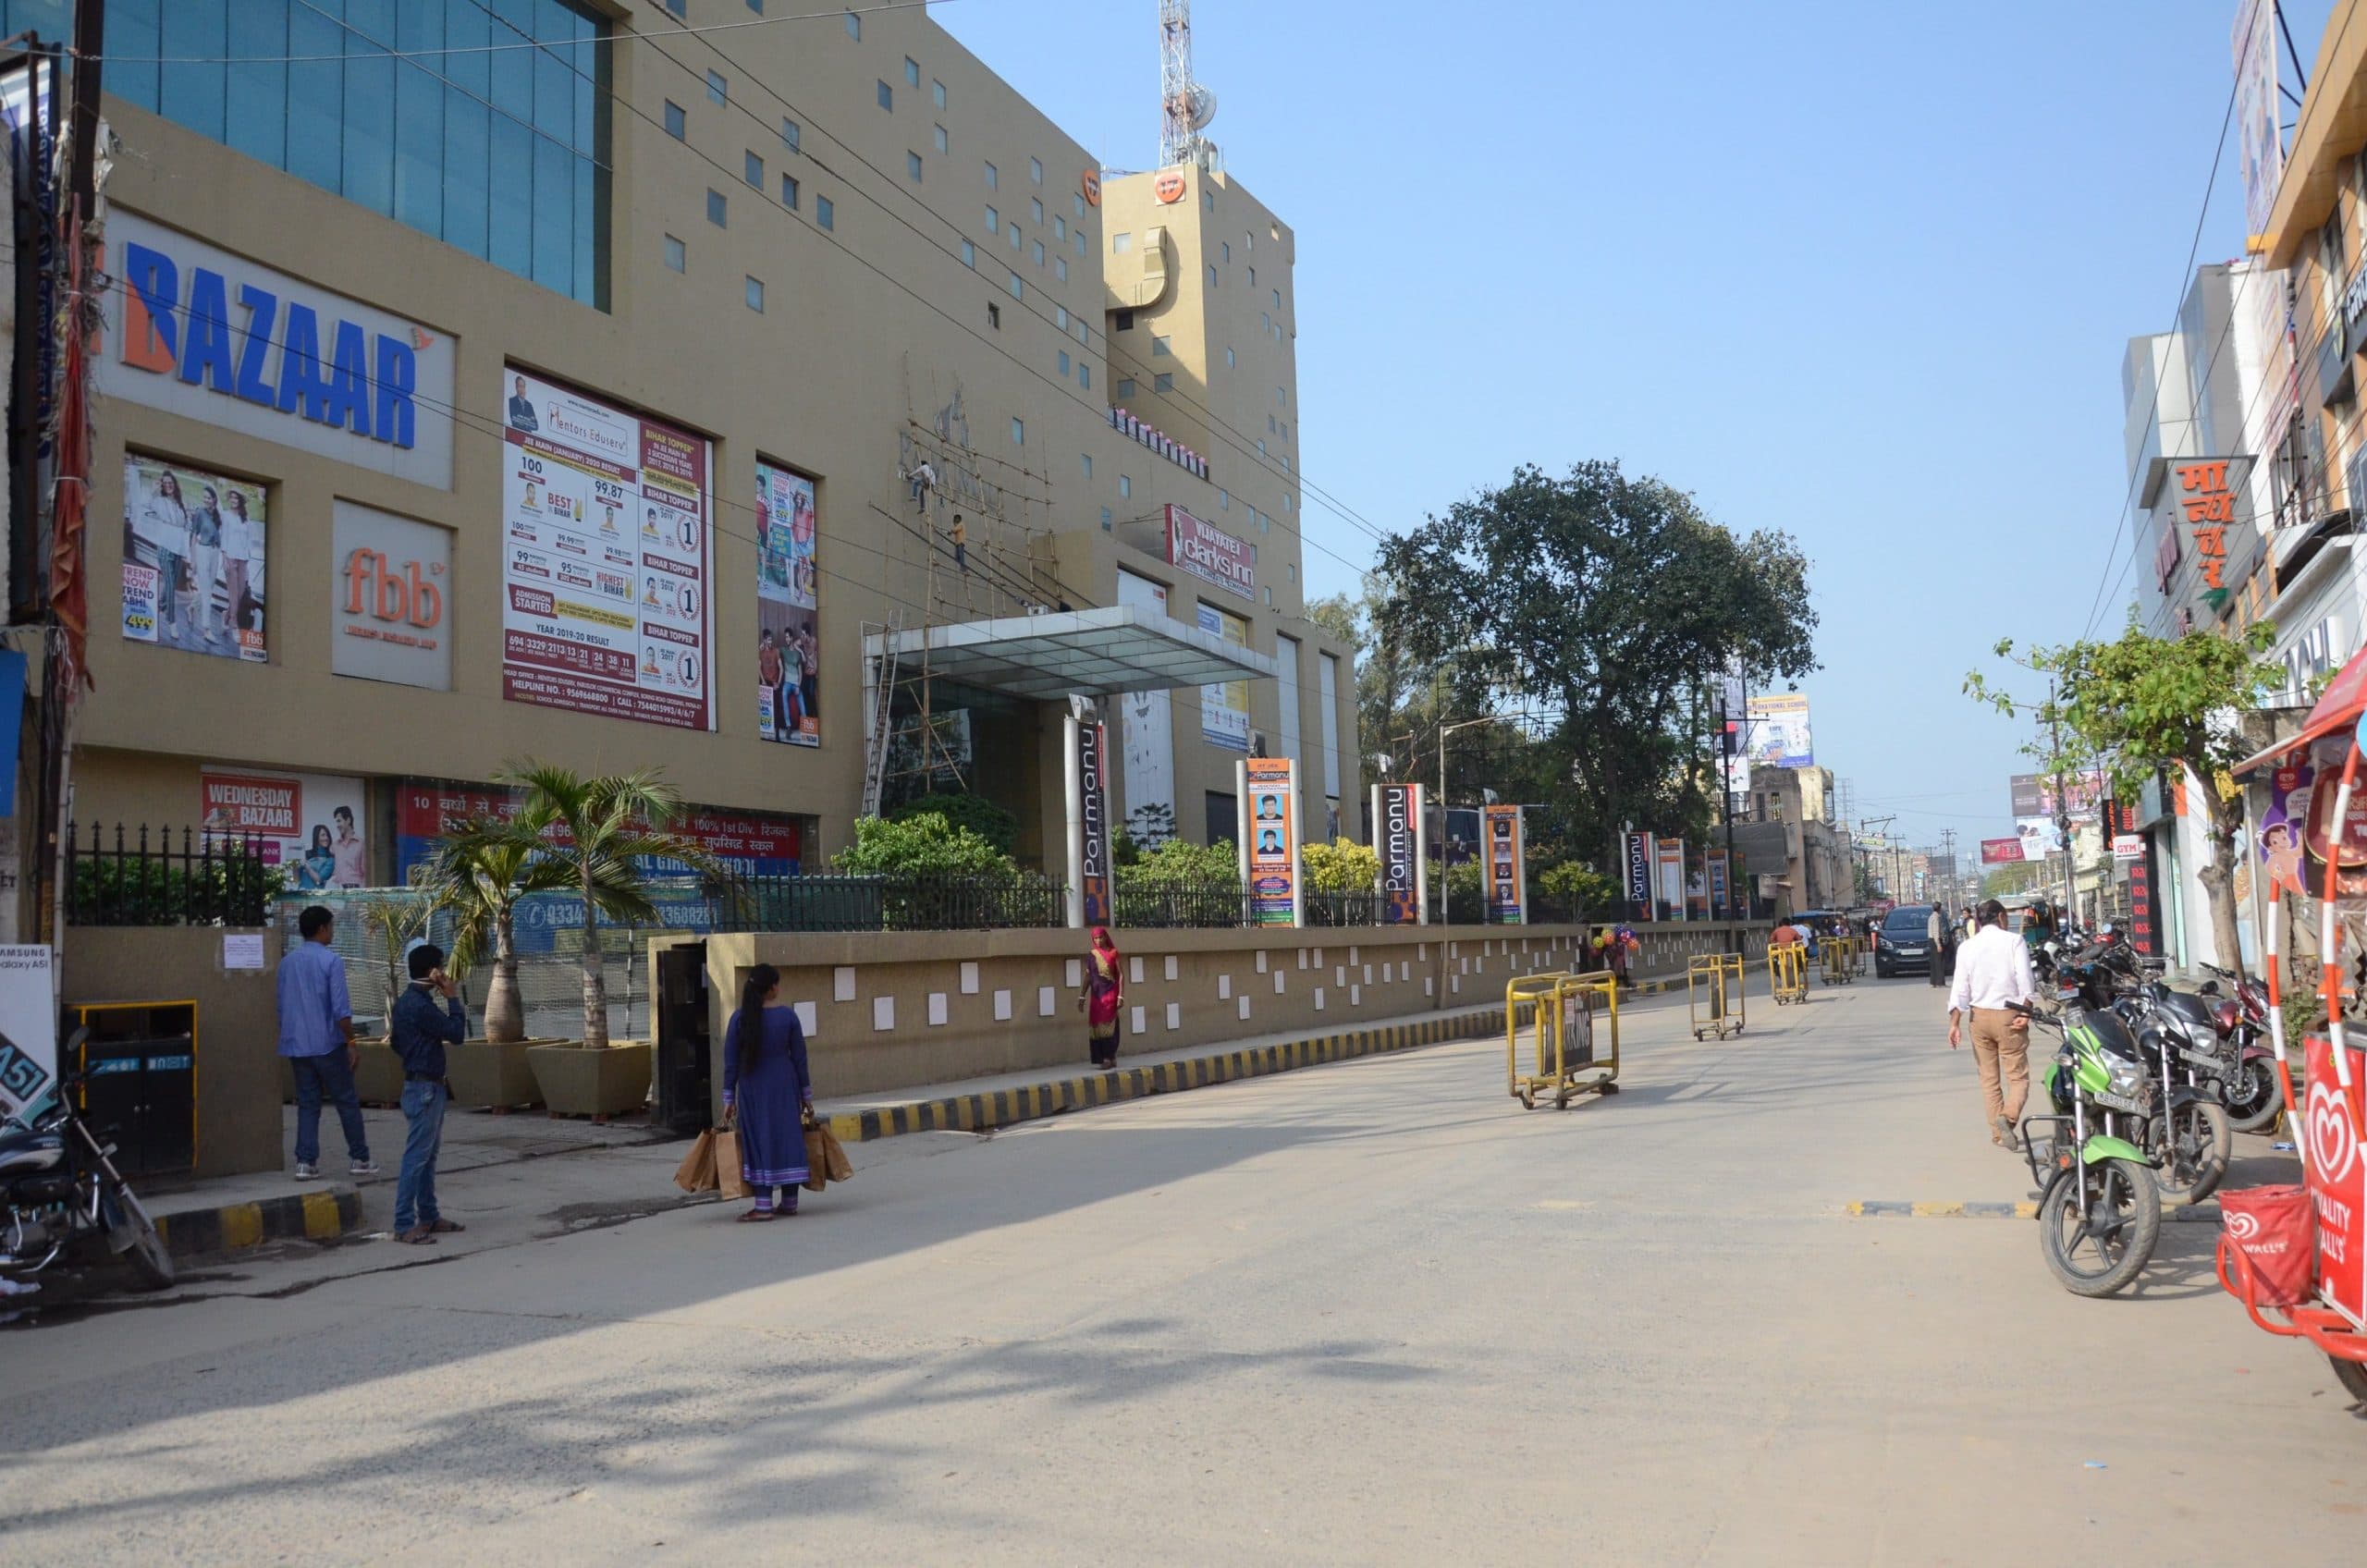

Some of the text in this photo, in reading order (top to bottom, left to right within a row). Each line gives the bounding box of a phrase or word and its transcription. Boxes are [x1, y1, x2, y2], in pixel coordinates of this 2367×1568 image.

[120, 241, 416, 449] BAZAAR
[550, 407, 627, 449] Mentors Eduserv
[645, 429, 666, 444] BIHAR
[535, 439, 553, 450] MAIN
[601, 461, 620, 474] RESULT
[521, 457, 542, 474] 100
[595, 481, 623, 499] 99.87
[647, 489, 667, 502] BIHAR
[547, 493, 571, 509] BEST
[555, 507, 571, 518] BIHAR
[512, 521, 524, 531] 100
[684, 522, 693, 545] 1
[1196, 521, 1241, 556] VIJAYATEJ
[517, 551, 529, 562] 99
[647, 557, 668, 570] BIHAR
[1184, 535, 1232, 575] clarks
[1232, 555, 1254, 587] inn
[561, 562, 571, 573] 95
[597, 571, 624, 586] HIGHEST
[342, 546, 442, 629] fbb
[604, 584, 624, 597] BIHAR
[516, 590, 551, 604] ADMISSION
[516, 597, 551, 612] STARTED
[684, 590, 693, 613] 1
[127, 614, 154, 631] 499
[246, 632, 264, 646] fbb
[536, 623, 610, 647] YEAR 2019-20 RESULT
[647, 625, 668, 638] BIHAR
[509, 636, 523, 646] 694
[527, 639, 546, 650] 3329
[547, 643, 566, 655] 2113
[568, 646, 577, 656] 13
[579, 649, 588, 659] 21
[594, 653, 603, 662] 24
[621, 658, 630, 668] 11
[661, 654, 673, 662] 2017
[518, 671, 534, 680] OFFICE
[684, 657, 693, 680] 1
[512, 679, 545, 692] HELPLINE
[546, 684, 560, 694] NO.
[618, 697, 632, 707] CALL
[209, 784, 292, 807] WEDNESDAY
[1084, 729, 1099, 877] Parmanu
[240, 806, 292, 828] BAZAAR
[414, 797, 429, 809] 10
[694, 819, 719, 832] 100%
[723, 822, 736, 834] 1st
[740, 823, 754, 836] Div.
[1385, 789, 1405, 891] Parmanu
[2117, 844, 2137, 853] GYM
[1631, 836, 1644, 902] Parmanu
[0, 949, 45, 958] AMSUNG
[0, 960, 48, 971] alaxy A51
[2241, 1240, 2289, 1254] WALL'S
[2319, 1227, 2347, 1266] ALL'S
